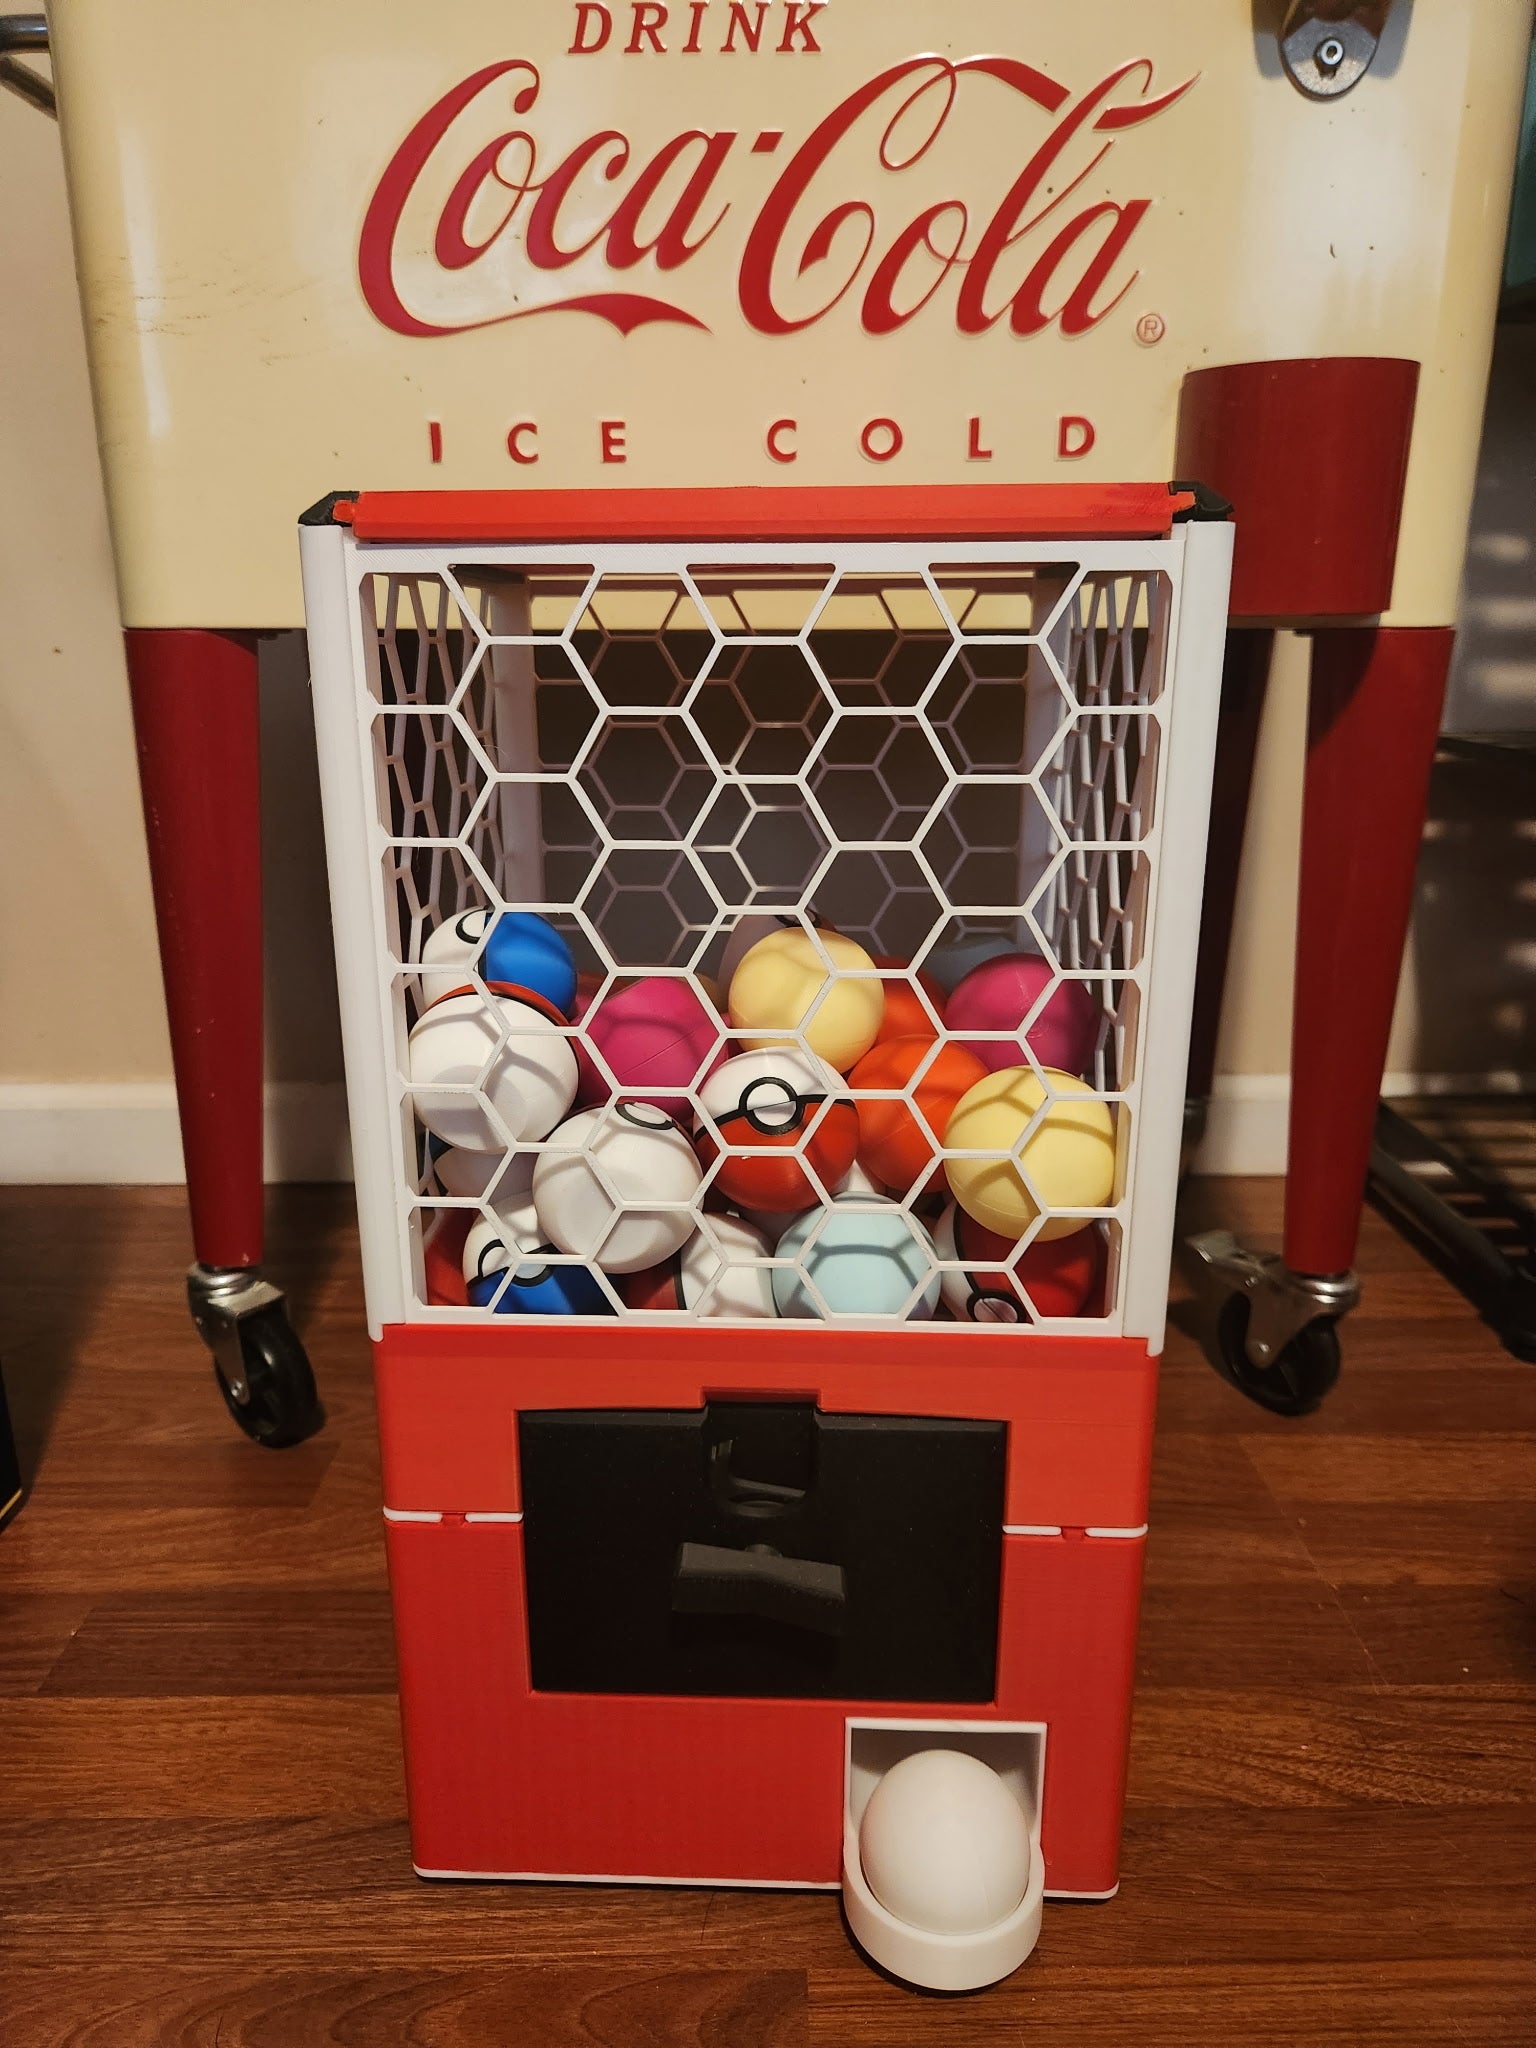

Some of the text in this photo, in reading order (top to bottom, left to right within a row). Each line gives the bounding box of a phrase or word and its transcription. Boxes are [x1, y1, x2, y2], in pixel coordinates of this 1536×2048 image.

[569, 1, 823, 54] DRINK
[357, 57, 1202, 338] Coca-Cola
[428, 416, 1097, 464] ICE COLD
